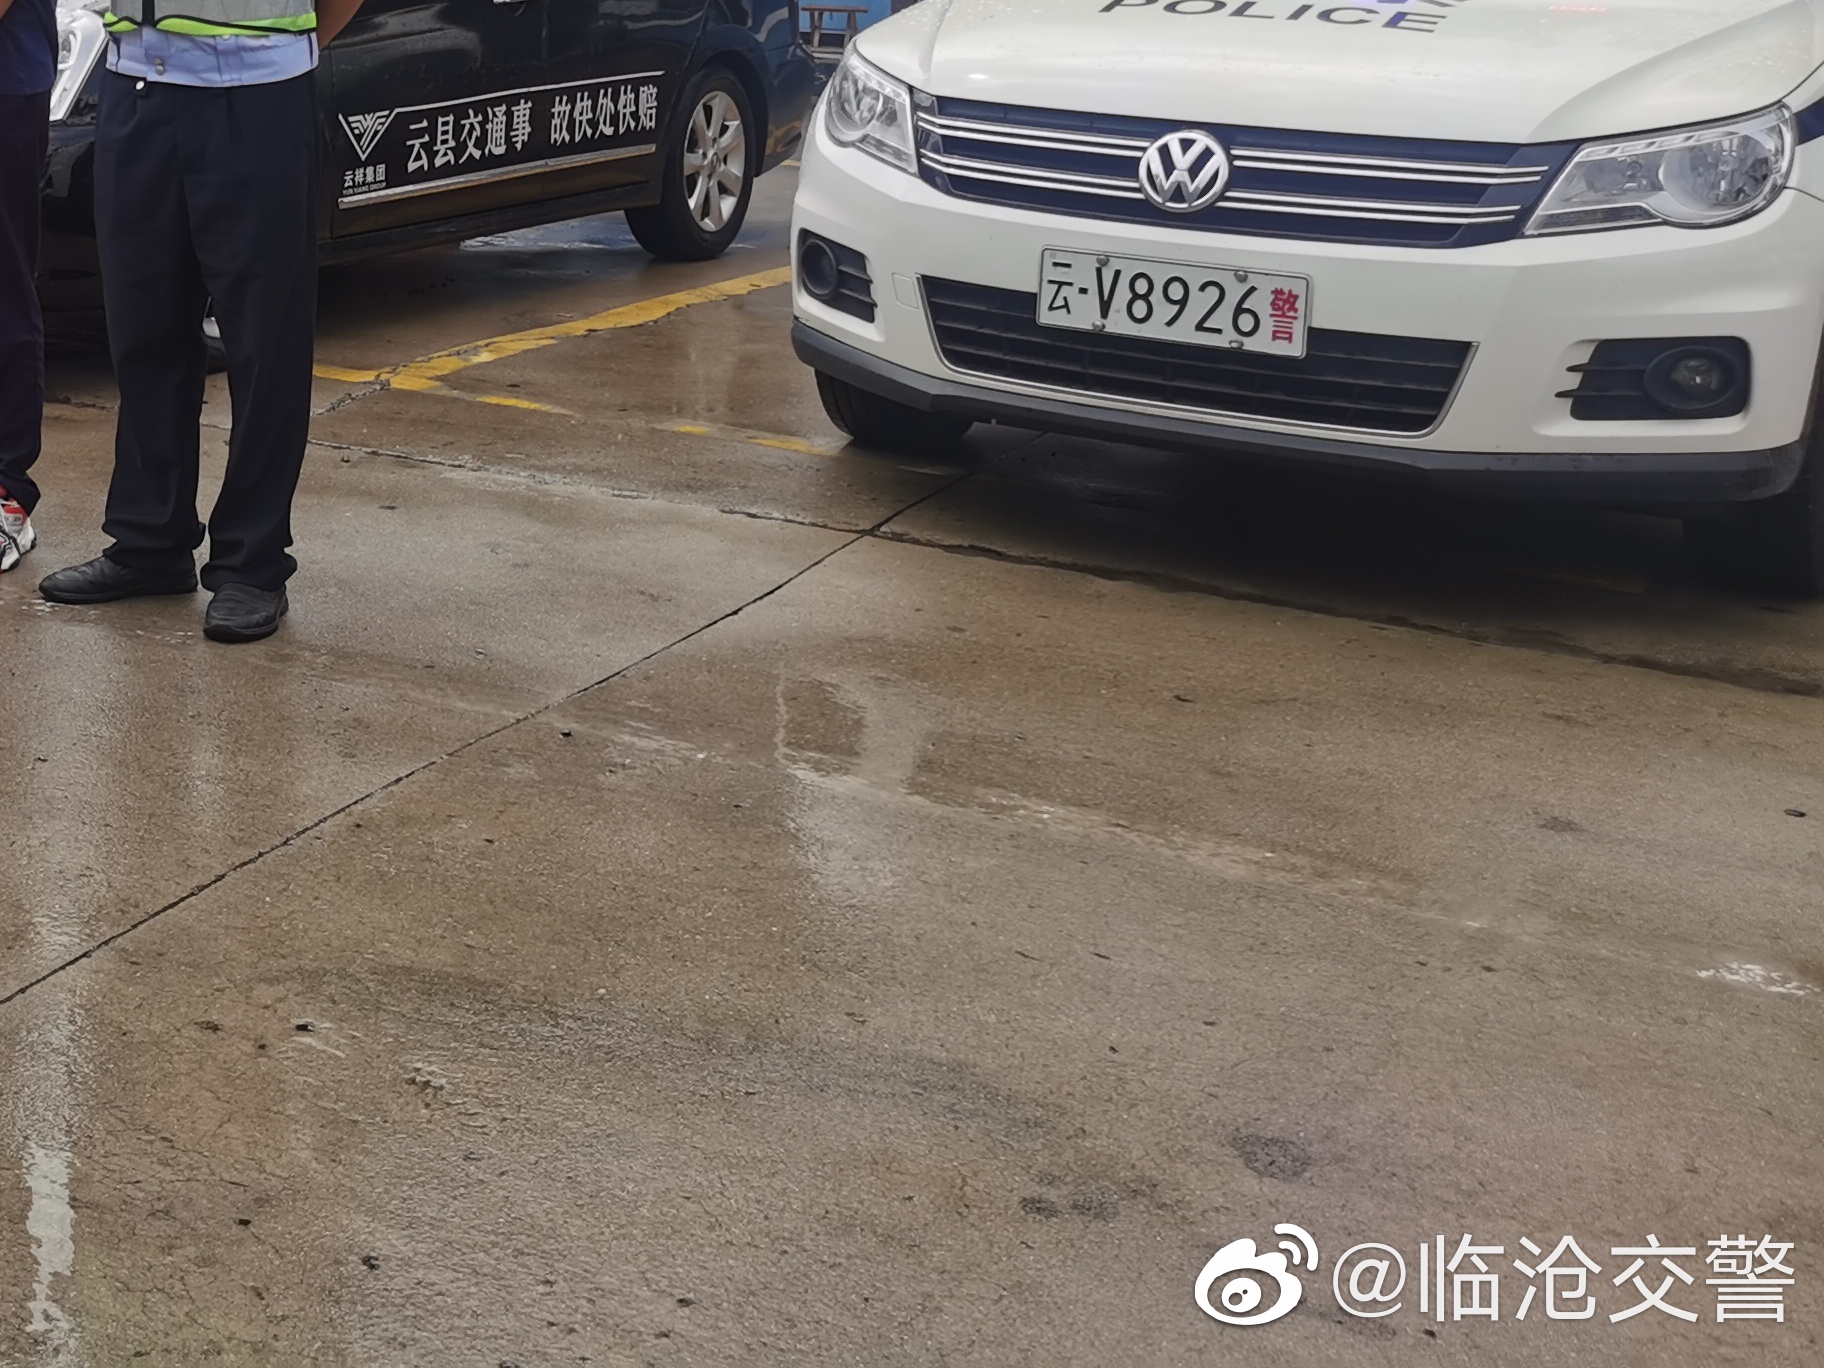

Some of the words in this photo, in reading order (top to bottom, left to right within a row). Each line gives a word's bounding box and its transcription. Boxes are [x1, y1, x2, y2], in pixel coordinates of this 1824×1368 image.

[405, 99, 532, 173] 云县交通事
[550, 83, 658, 147] 故快处快赔
